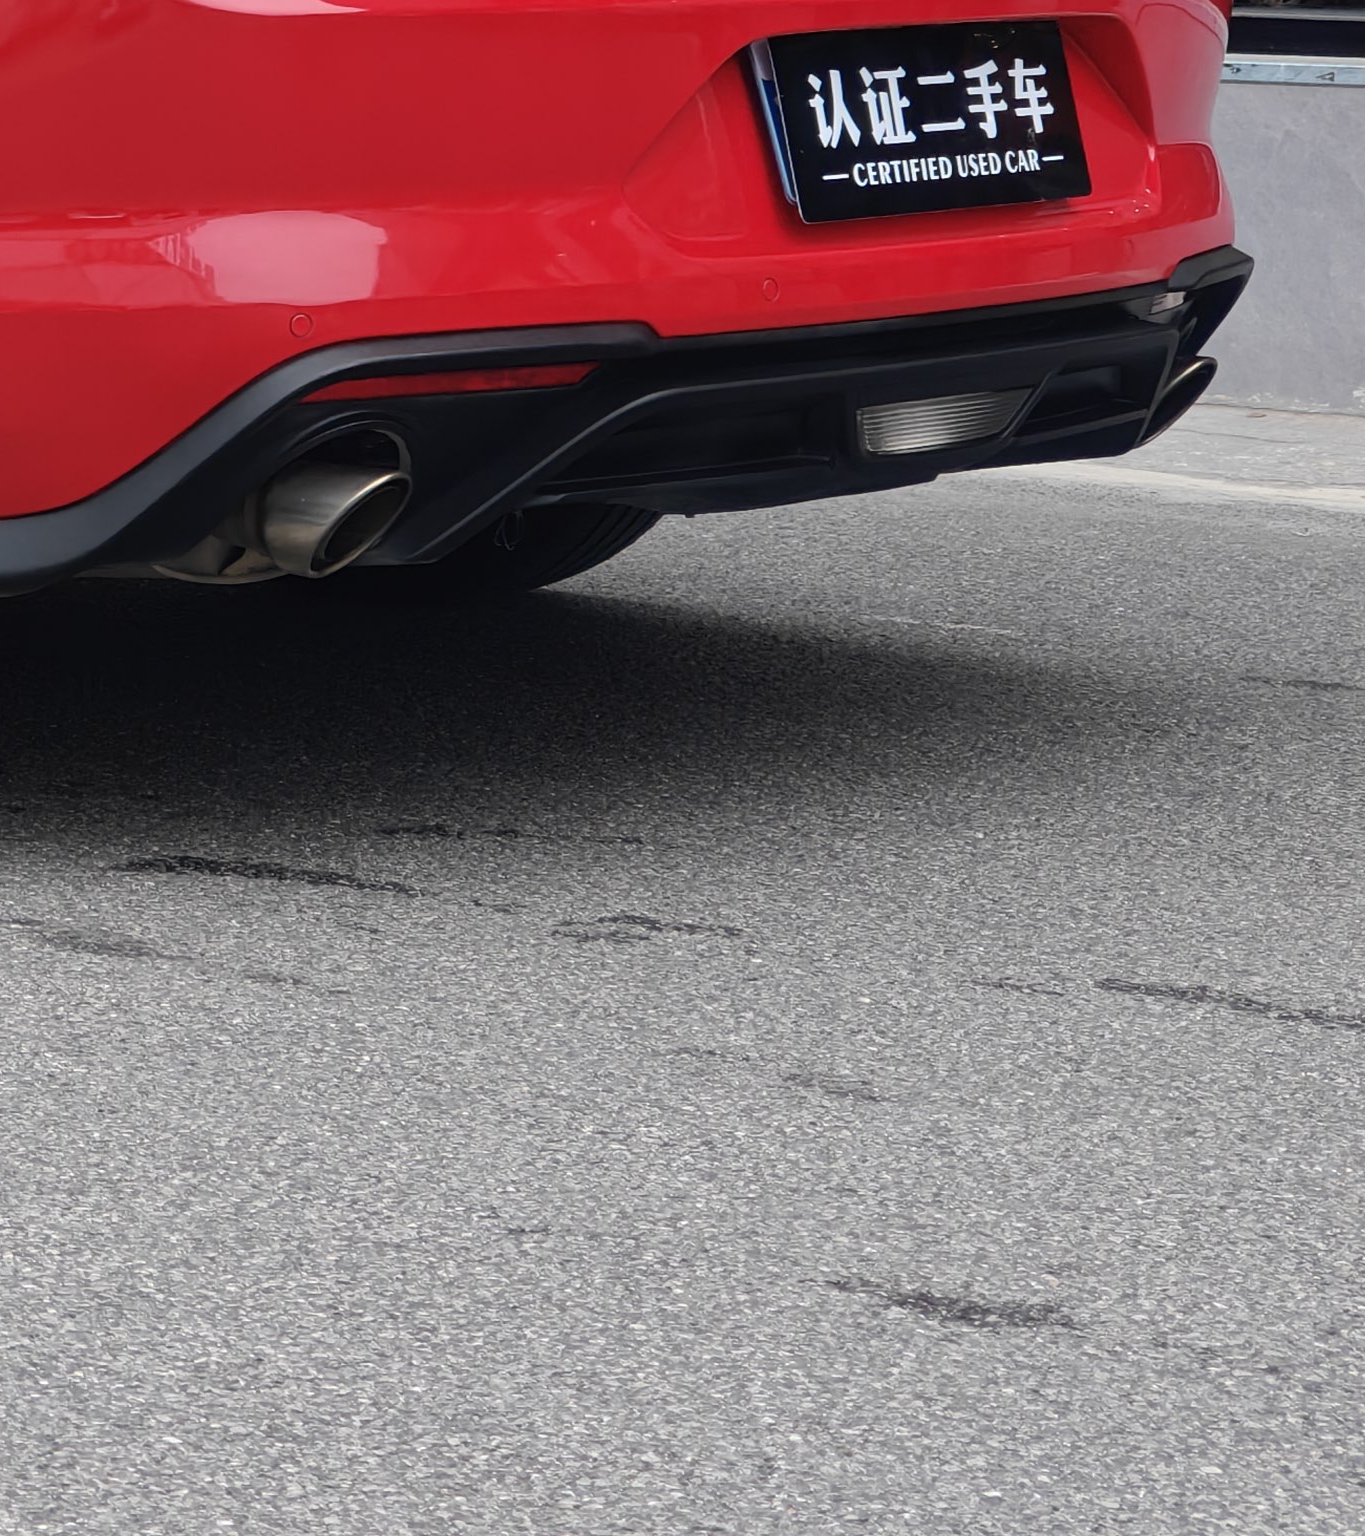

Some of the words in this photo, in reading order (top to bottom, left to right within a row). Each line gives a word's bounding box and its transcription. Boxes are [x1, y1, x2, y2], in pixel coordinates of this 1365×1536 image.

[808, 58, 1055, 150] 认证二手车
[852, 158, 953, 188] CERTIFIED
[956, 153, 1003, 182] USED
[1005, 149, 1040, 176] CAR
